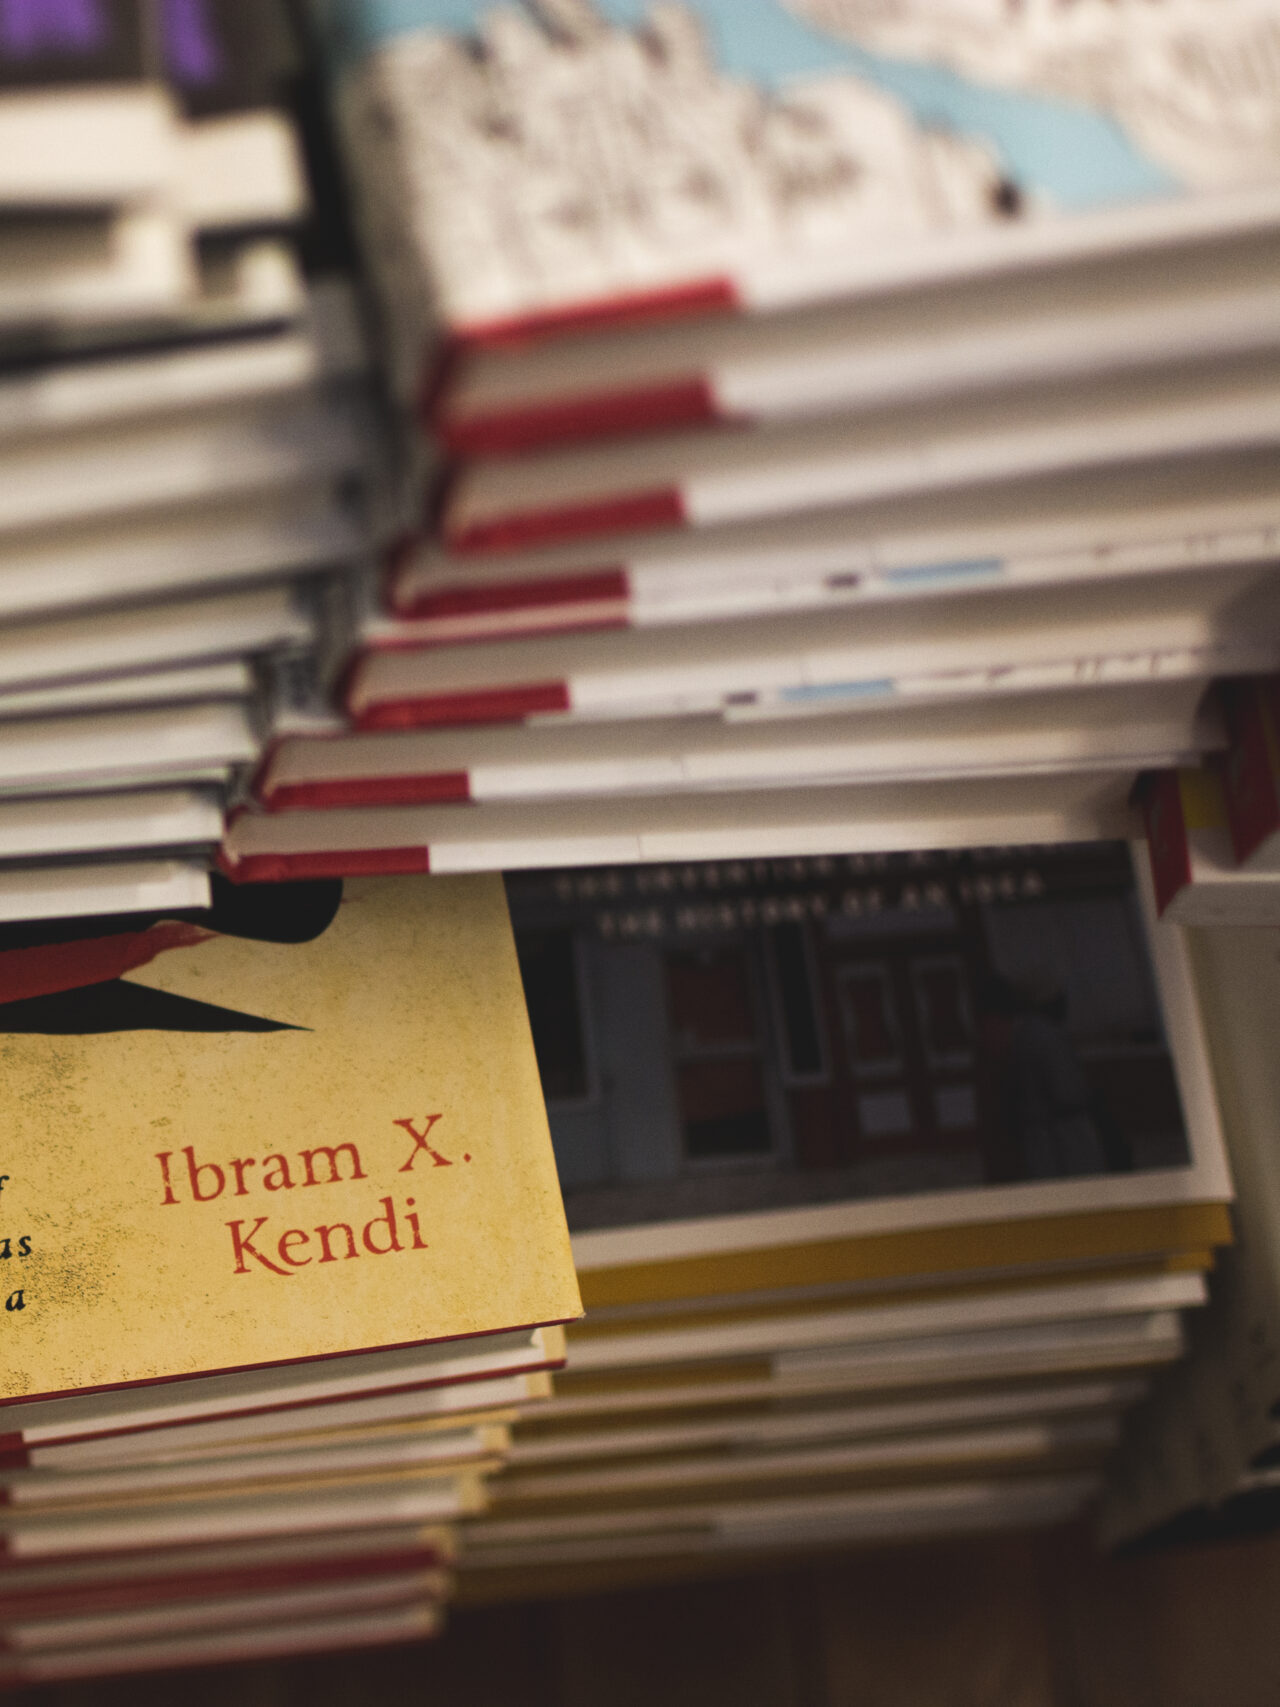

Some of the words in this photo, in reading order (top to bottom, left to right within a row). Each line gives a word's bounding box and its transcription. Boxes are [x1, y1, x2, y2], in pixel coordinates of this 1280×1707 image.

[154, 1142, 368, 1205] Ibram
[392, 1113, 472, 1173] X.
[224, 1196, 429, 1277] Kendi
